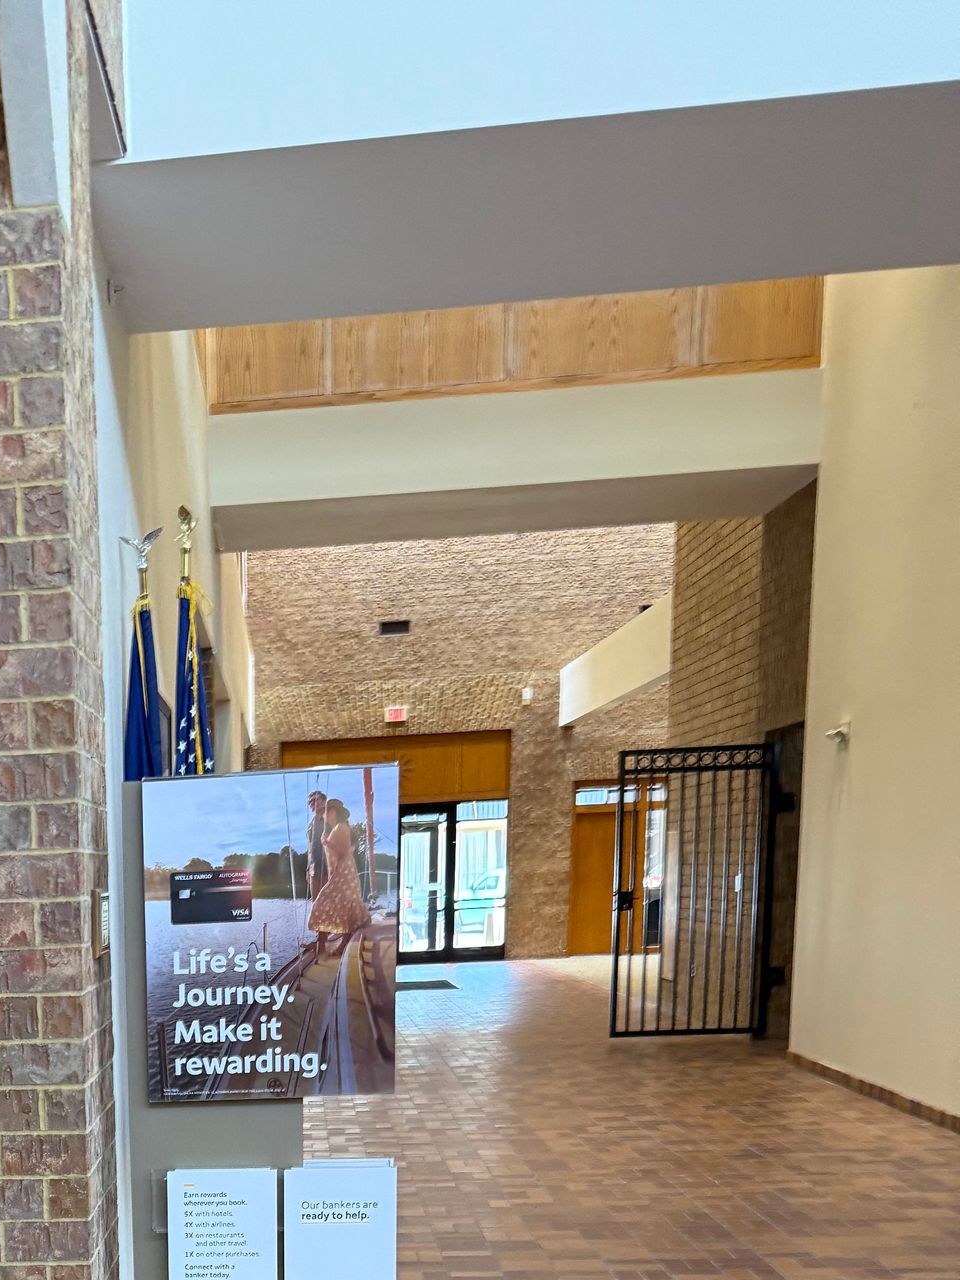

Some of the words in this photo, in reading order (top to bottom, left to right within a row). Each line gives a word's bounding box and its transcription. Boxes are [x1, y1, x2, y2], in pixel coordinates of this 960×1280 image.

[173, 947, 248, 975] Life’s
[255, 952, 271, 971] a
[172, 983, 294, 1011] Journey.
[174, 1018, 253, 1044] Make
[260, 1015, 282, 1041] it
[174, 1047, 327, 1078] rewarding.
[301, 1201, 319, 1209] Our
[322, 1200, 360, 1209] bankers
[301, 1212, 329, 1221] ready
[345, 1210, 369, 1221] help.
